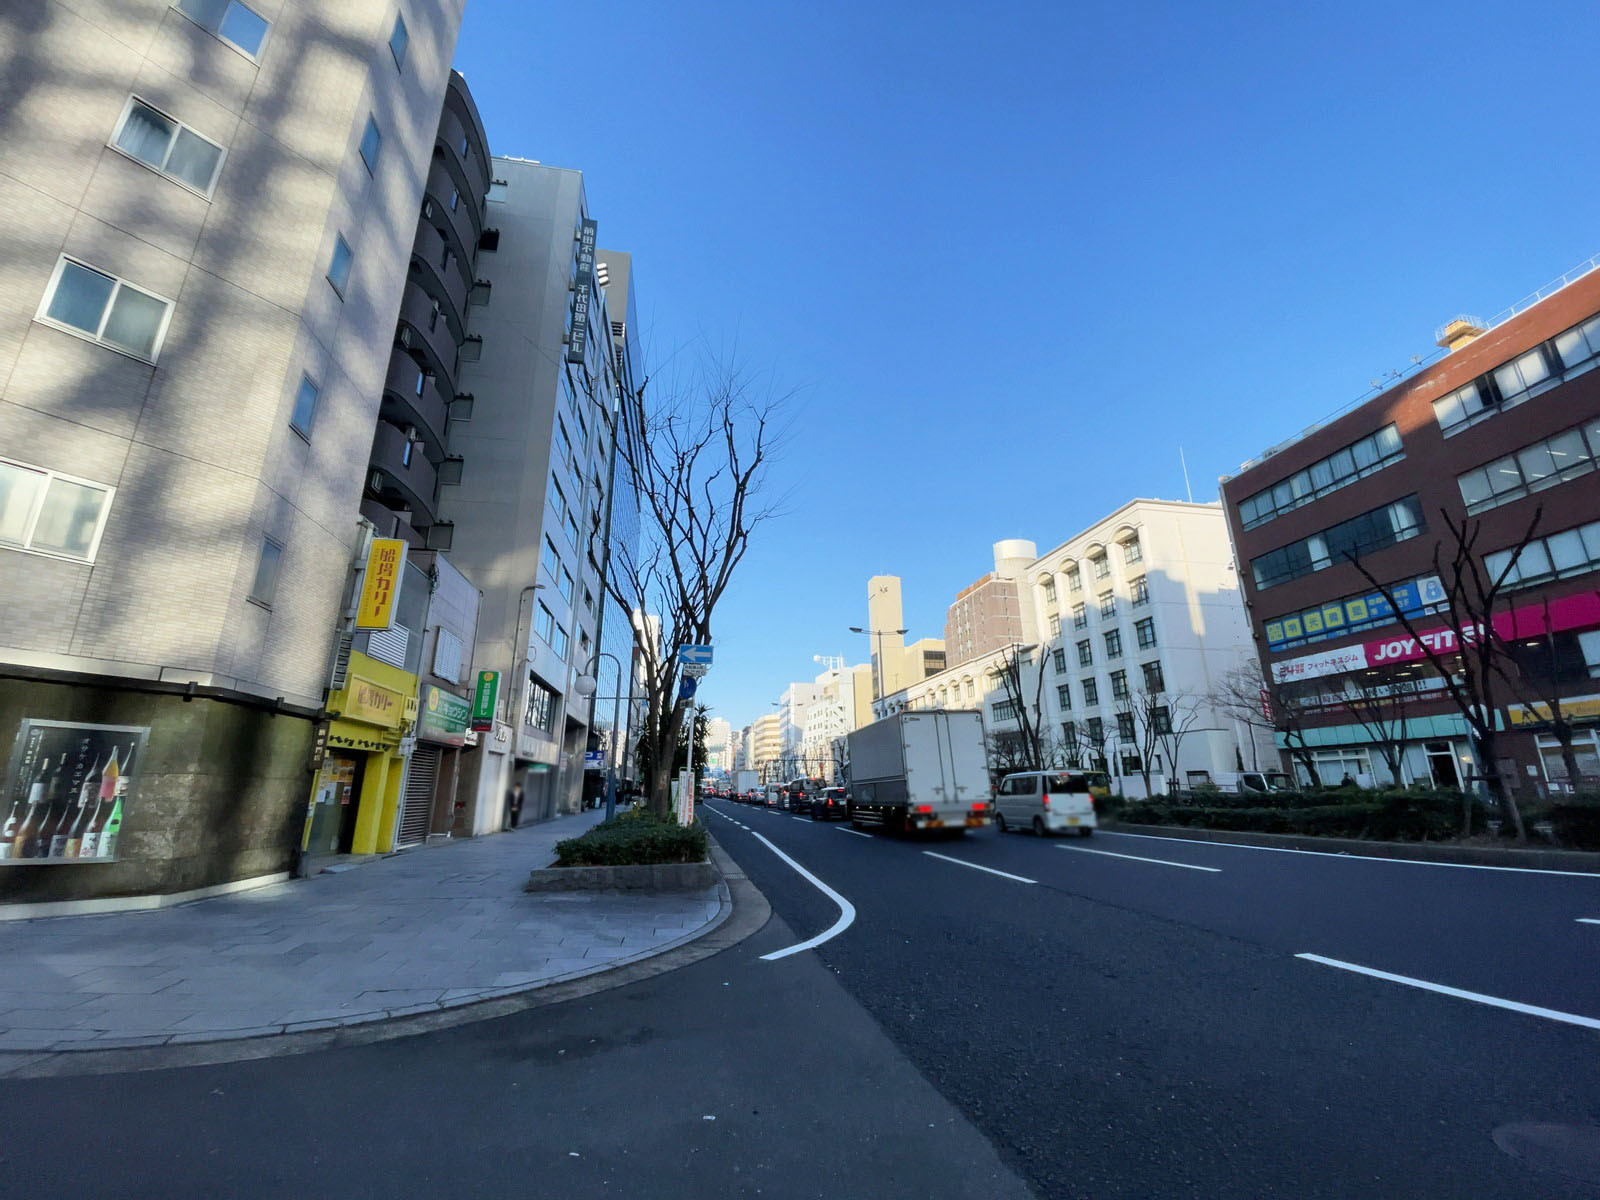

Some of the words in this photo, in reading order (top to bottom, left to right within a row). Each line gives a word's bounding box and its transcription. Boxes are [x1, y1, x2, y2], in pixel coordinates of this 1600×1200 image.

[579, 226, 594, 273] 前田不動産
[374, 548, 396, 617] 船場カリー
